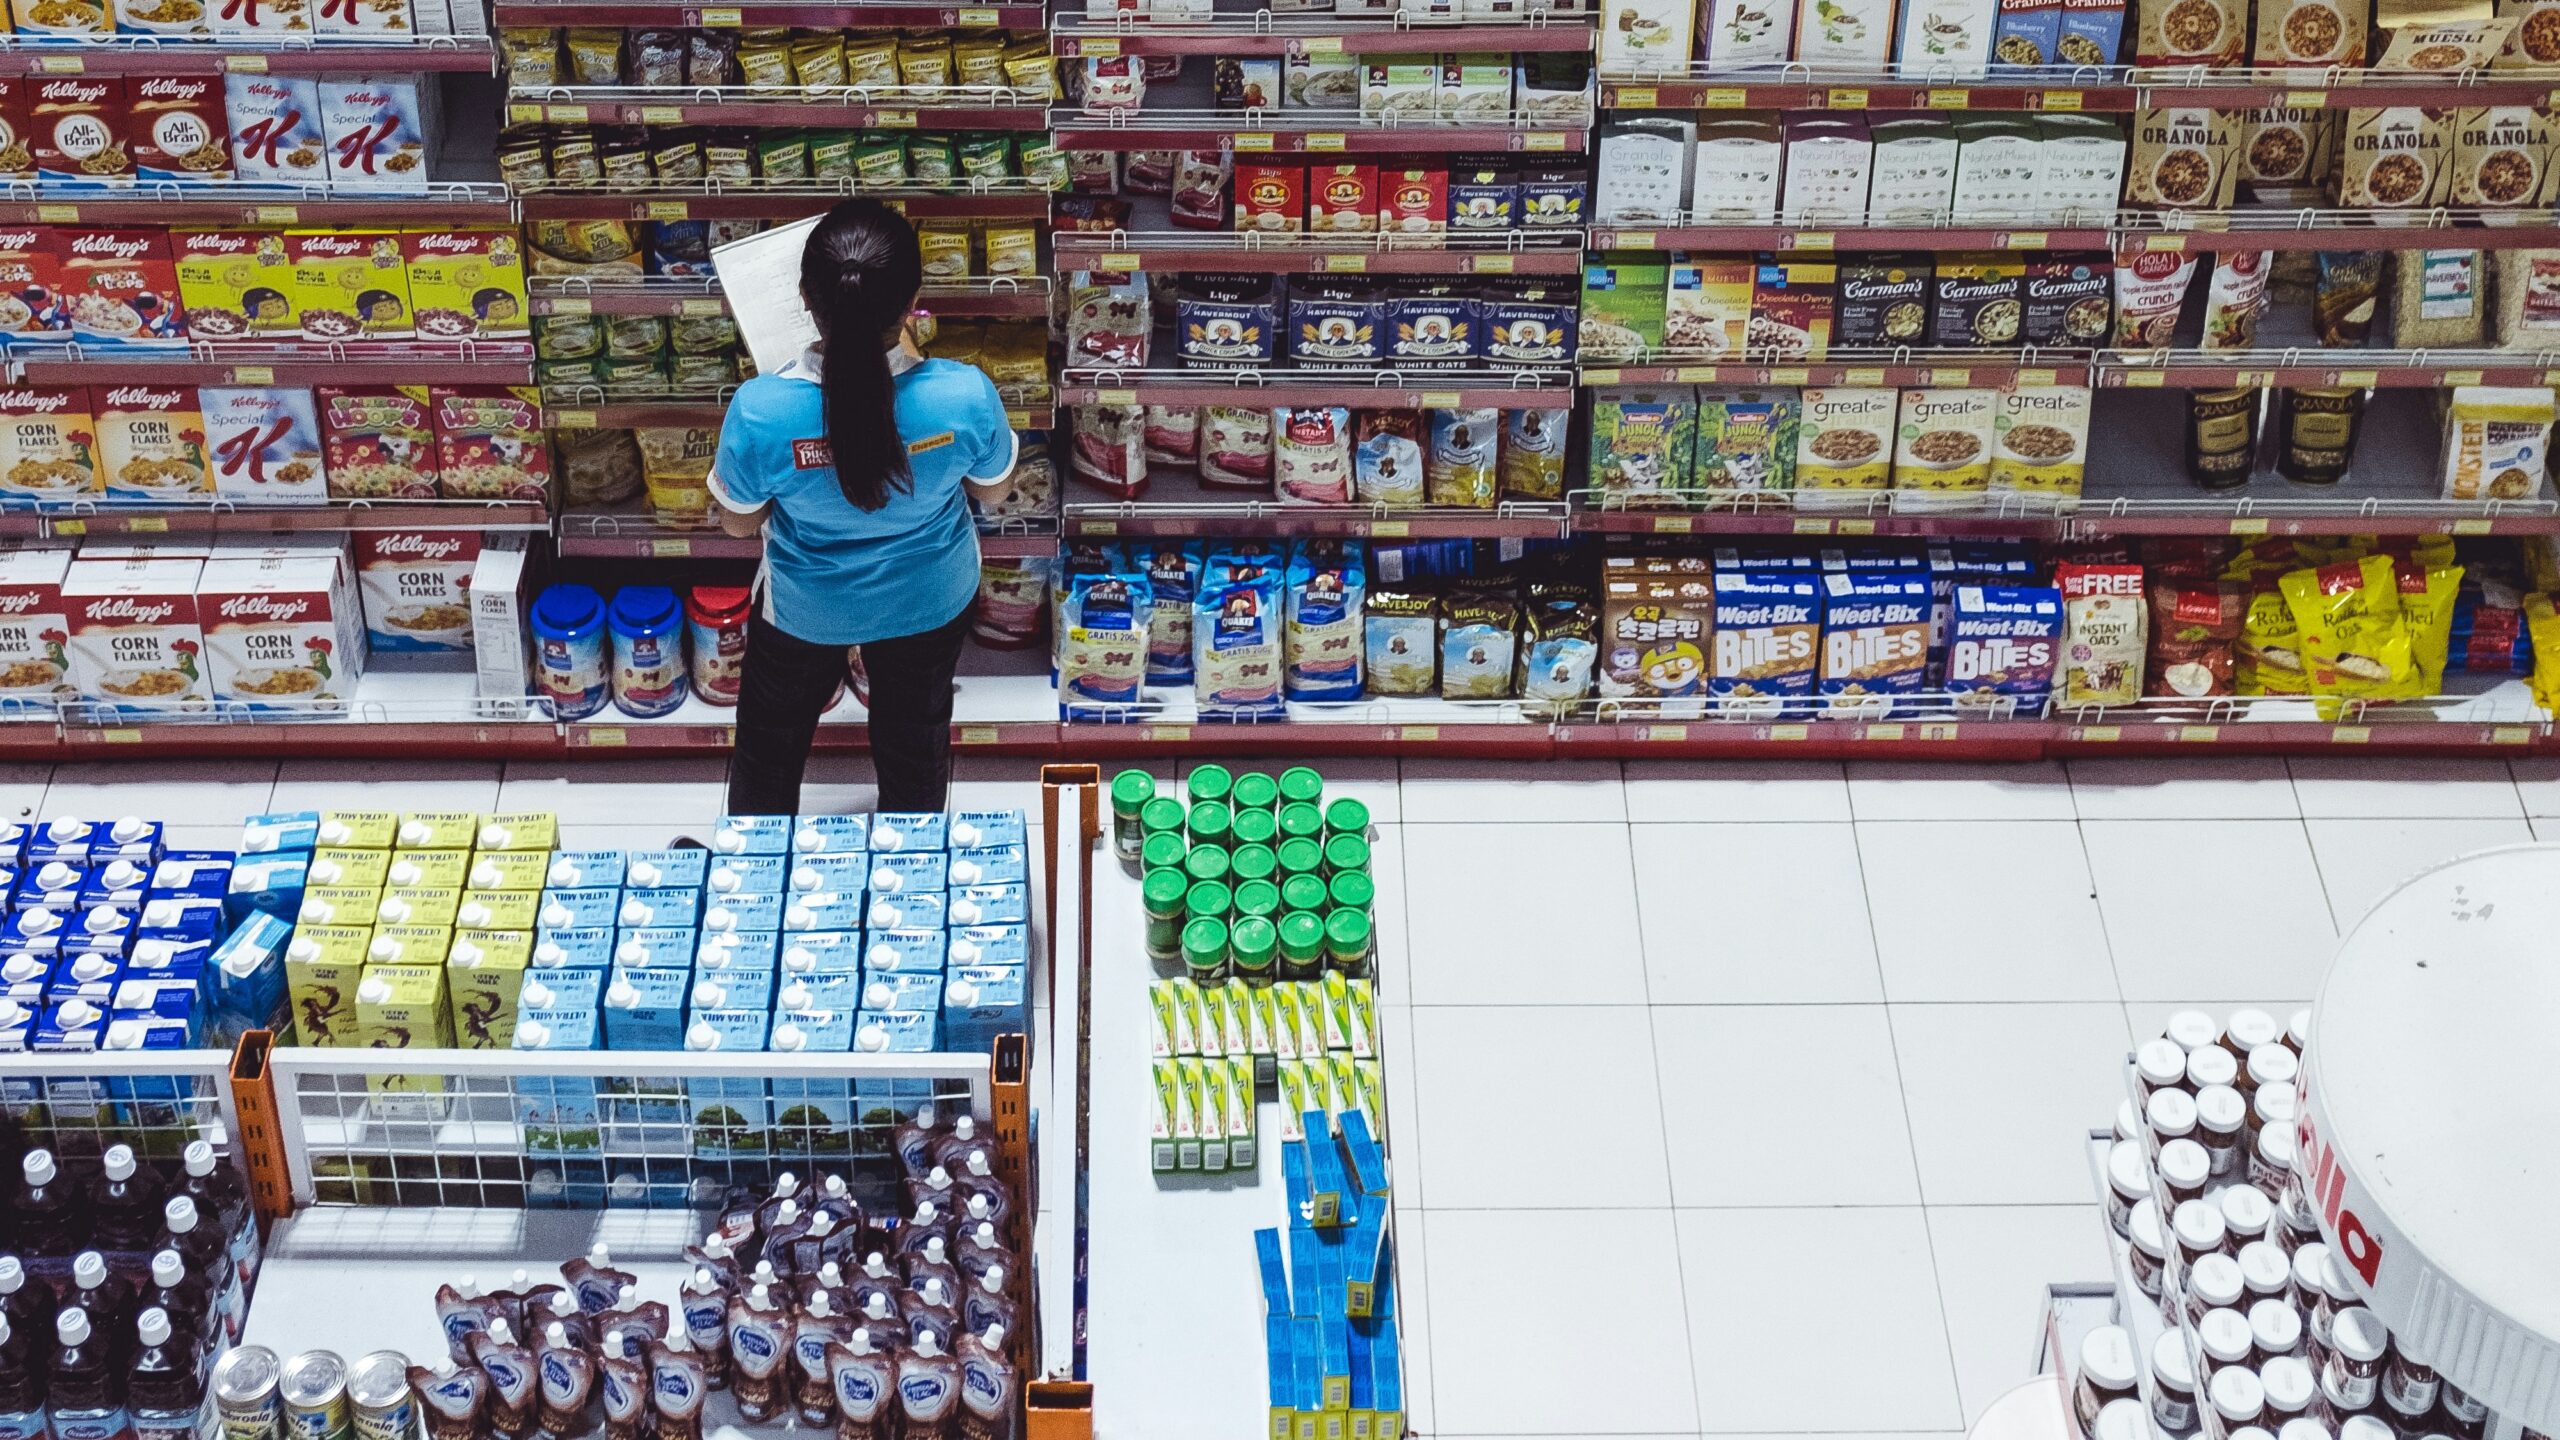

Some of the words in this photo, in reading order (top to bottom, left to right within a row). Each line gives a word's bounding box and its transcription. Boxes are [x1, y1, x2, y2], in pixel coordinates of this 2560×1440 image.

[2006, 20, 2046, 34] Blueberry
[2068, 19, 2107, 33] Blueberry
[2412, 32, 2484, 44] MUESLI
[744, 53, 780, 66] ENERGEN
[907, 61, 942, 72] ENERGEN
[42, 81, 107, 101] Kellogg's
[141, 78, 205, 98] Kellogg's
[236, 103, 278, 117] Special
[332, 113, 377, 126] Special
[64, 133, 100, 146] Bran
[164, 131, 199, 144] Bran
[240, 109, 300, 168] K
[2142, 128, 2228, 145] GRANOLA
[2354, 134, 2440, 150] GRANOLA
[2462, 129, 2548, 146] GRANOLA
[336, 115, 400, 175] K
[657, 144, 694, 163] ENERGEN
[862, 151, 899, 168] ENERGEN
[1610, 146, 1673, 162] Granola
[72, 235, 150, 257] Kellogg's
[187, 234, 247, 252] Kellogg's
[302, 237, 360, 254] Kellogg's
[418, 234, 479, 252] Kellogg's
[924, 239, 965, 248] ENERGEN
[990, 236, 1031, 247] ENERGEN
[1844, 278, 1923, 299] Carman's
[1939, 278, 2018, 299] Carman's
[2028, 276, 2107, 298] Carman's
[1210, 290, 1238, 302] Ligo
[1324, 290, 1352, 300] Ligo
[1700, 296, 1749, 306] Chocolate
[2138, 292, 2174, 306] crunch
[1194, 310, 1250, 319] HAVERMOUT
[1308, 308, 1365, 318] HAVERMOUT
[1404, 307, 1460, 315] HAVERMOUT
[1498, 312, 1556, 320] HAVERMOUT
[1187, 361, 1225, 369] WHITE
[1300, 362, 1338, 370] WHITE
[1395, 361, 1434, 369] WHITE
[1437, 361, 1467, 369] OATS
[107, 387, 182, 409] Kellogg's
[1914, 398, 1971, 422] great
[2007, 394, 2064, 415] great
[1815, 400, 1870, 422] great
[212, 414, 264, 426] Special
[17, 424, 56, 436] CORN
[129, 422, 169, 434] CORN
[1620, 424, 1664, 436] JUNGLE
[1726, 424, 1770, 436] JUNGLE
[19, 435, 59, 446] FLAKES
[132, 434, 172, 444] FLAKES
[216, 416, 293, 483] K
[376, 534, 461, 556] Kellogg's
[398, 572, 444, 586] CORN
[2082, 574, 2142, 594] FREE
[400, 587, 446, 597] FLAKES
[1855, 584, 1900, 594] Weet-Bix
[1306, 592, 1342, 602] QUAKER
[220, 596, 308, 620] Kellogg's
[480, 599, 507, 608] CORN
[1986, 602, 2032, 613] Weet-Bix
[86, 598, 175, 622] Kellogg's
[1716, 605, 1811, 624] Weet-Bix
[1828, 604, 1922, 625] Weet-Bix
[1222, 616, 1254, 627] QUAKER
[1957, 620, 2052, 636] Weet-Bix
[2080, 624, 2128, 634] INSTANT
[246, 635, 292, 648] CORN
[1088, 632, 1116, 641] GRATIS
[2089, 636, 2119, 646] OATS
[112, 637, 158, 650] CORN
[115, 651, 162, 661] FLAKES
[248, 650, 294, 660] FLAKES
[334, 812, 358, 820] MILK
[360, 812, 388, 822] ULTRA
[413, 812, 436, 820] MILK
[439, 813, 468, 822] ULTRA
[490, 815, 516, 824] MILK
[518, 814, 547, 822] ULTRA
[324, 852, 348, 860] MILK
[350, 852, 380, 860] ULTRA
[403, 853, 426, 861] MILK
[430, 853, 458, 862] ULTRA
[314, 889, 339, 897] MILK
[342, 890, 372, 898] ULTRA
[304, 928, 328, 937] MILK
[331, 929, 361, 938] ULTRA
[384, 928, 408, 936] MILK
[410, 928, 441, 936] ULTRA
[372, 968, 398, 976] MILK
[400, 968, 430, 977] ULTRA
[528, 1012, 554, 1020] MILK
[556, 1011, 587, 1020] ULTRA
